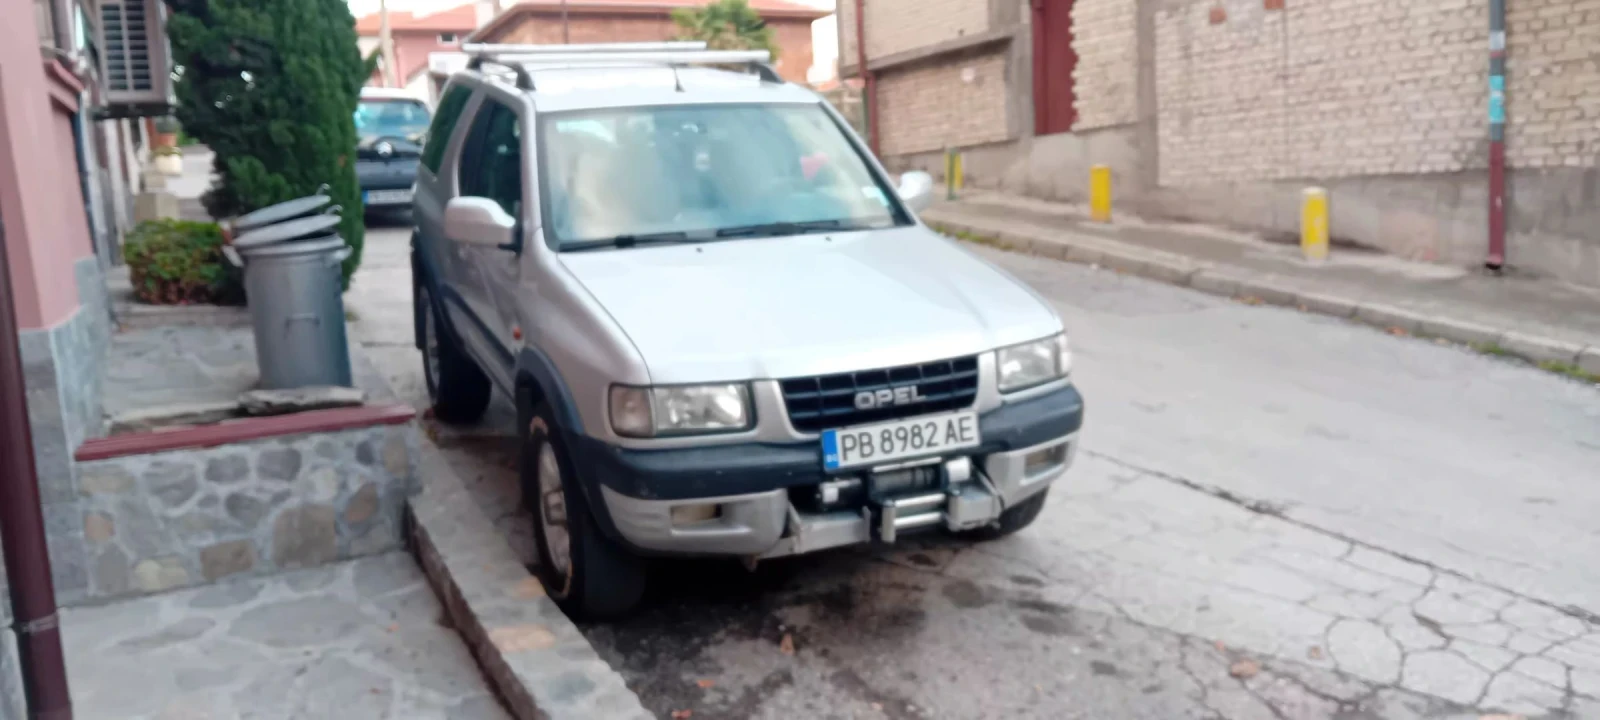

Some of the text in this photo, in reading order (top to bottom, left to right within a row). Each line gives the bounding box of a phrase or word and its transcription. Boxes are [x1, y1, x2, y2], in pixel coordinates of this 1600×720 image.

[854, 385, 926, 410] OPEL
[840, 416, 974, 461] PB 8982 AE
